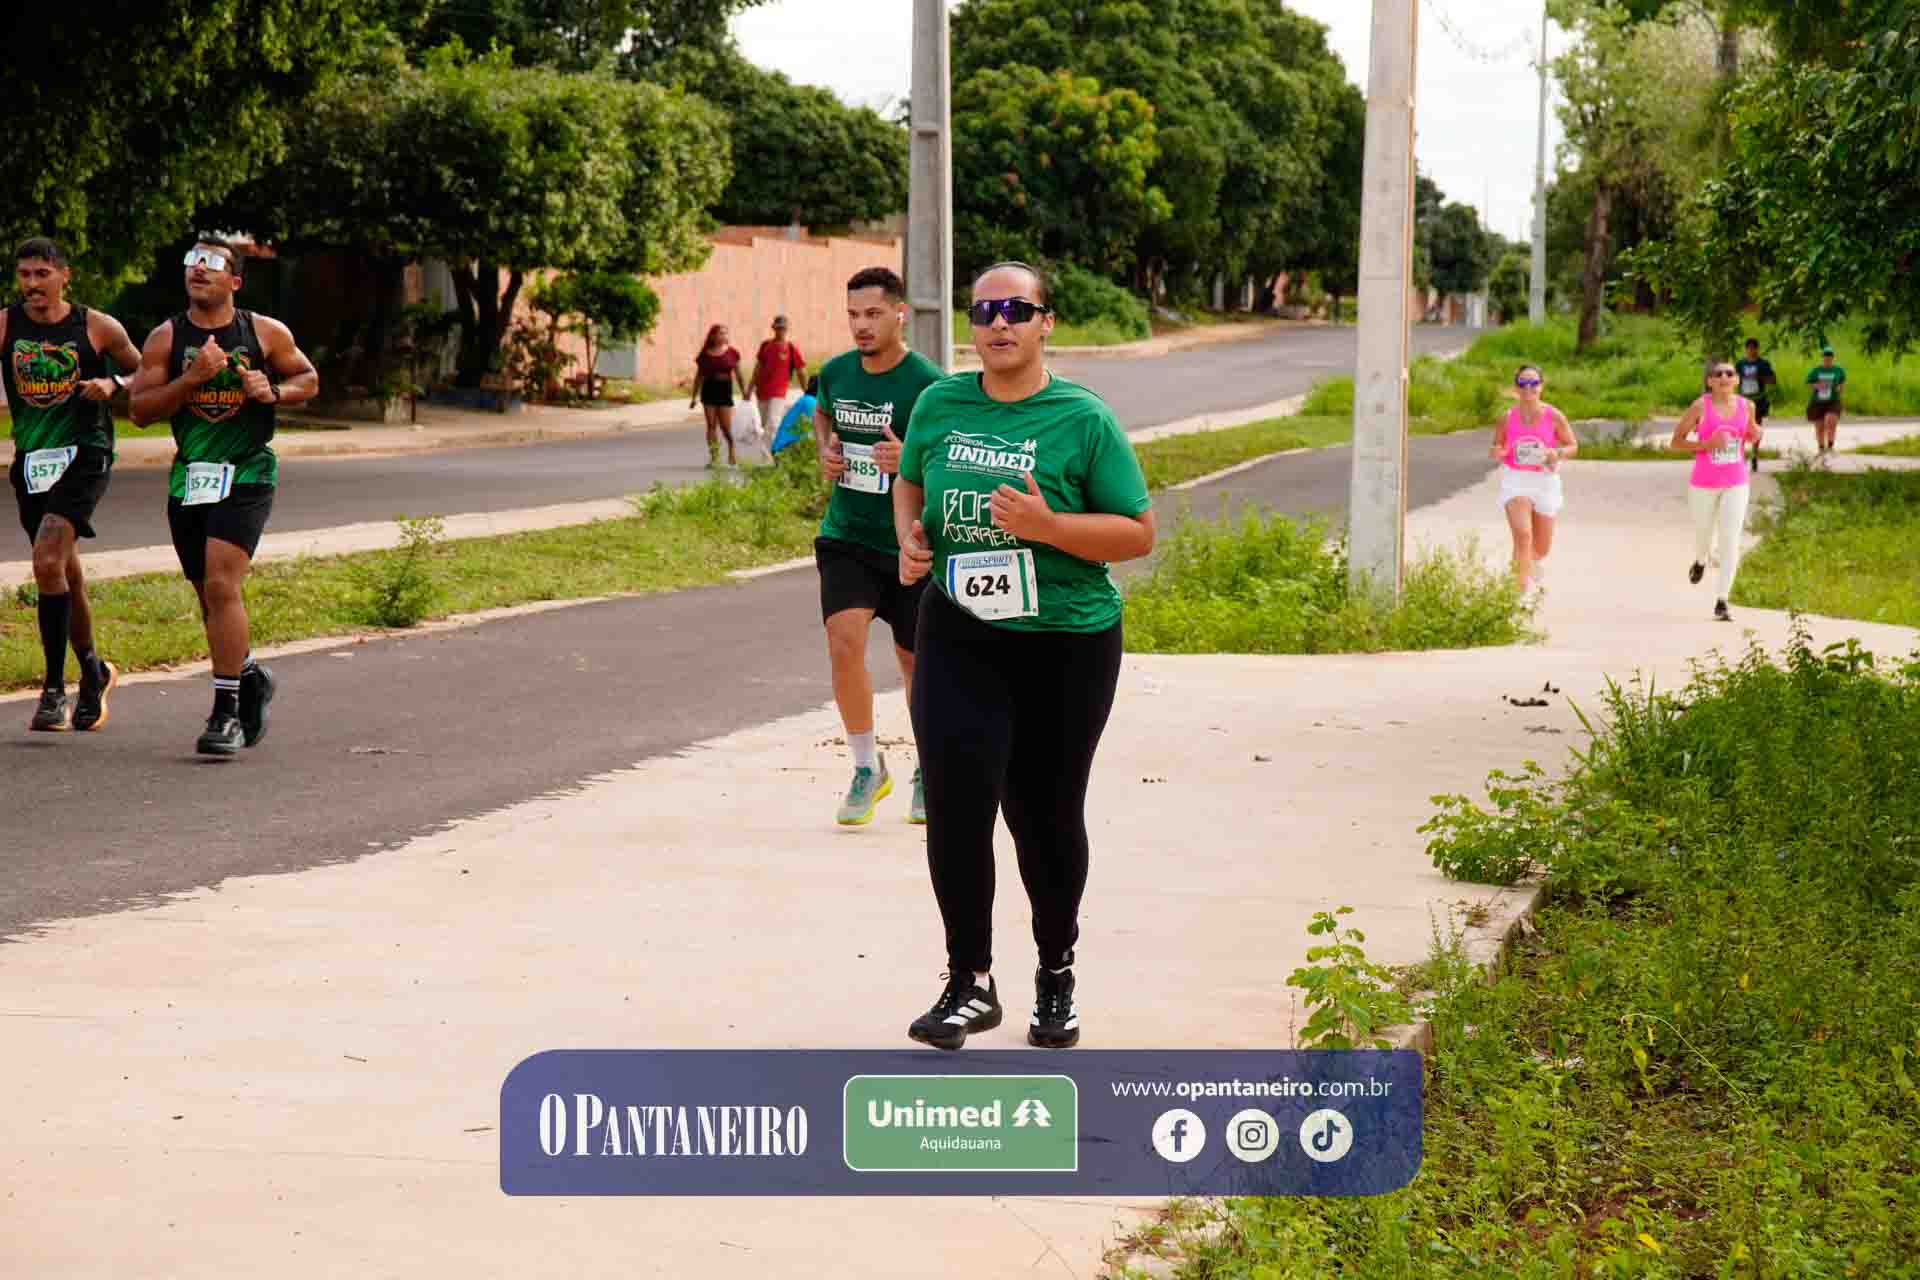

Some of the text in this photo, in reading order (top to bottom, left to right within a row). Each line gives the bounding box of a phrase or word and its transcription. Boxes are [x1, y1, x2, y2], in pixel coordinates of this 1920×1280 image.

[835, 409, 893, 426] UNIMED
[844, 456, 878, 477] 3485
[947, 443, 1036, 472] UNIMED
[965, 574, 1011, 598] 624
